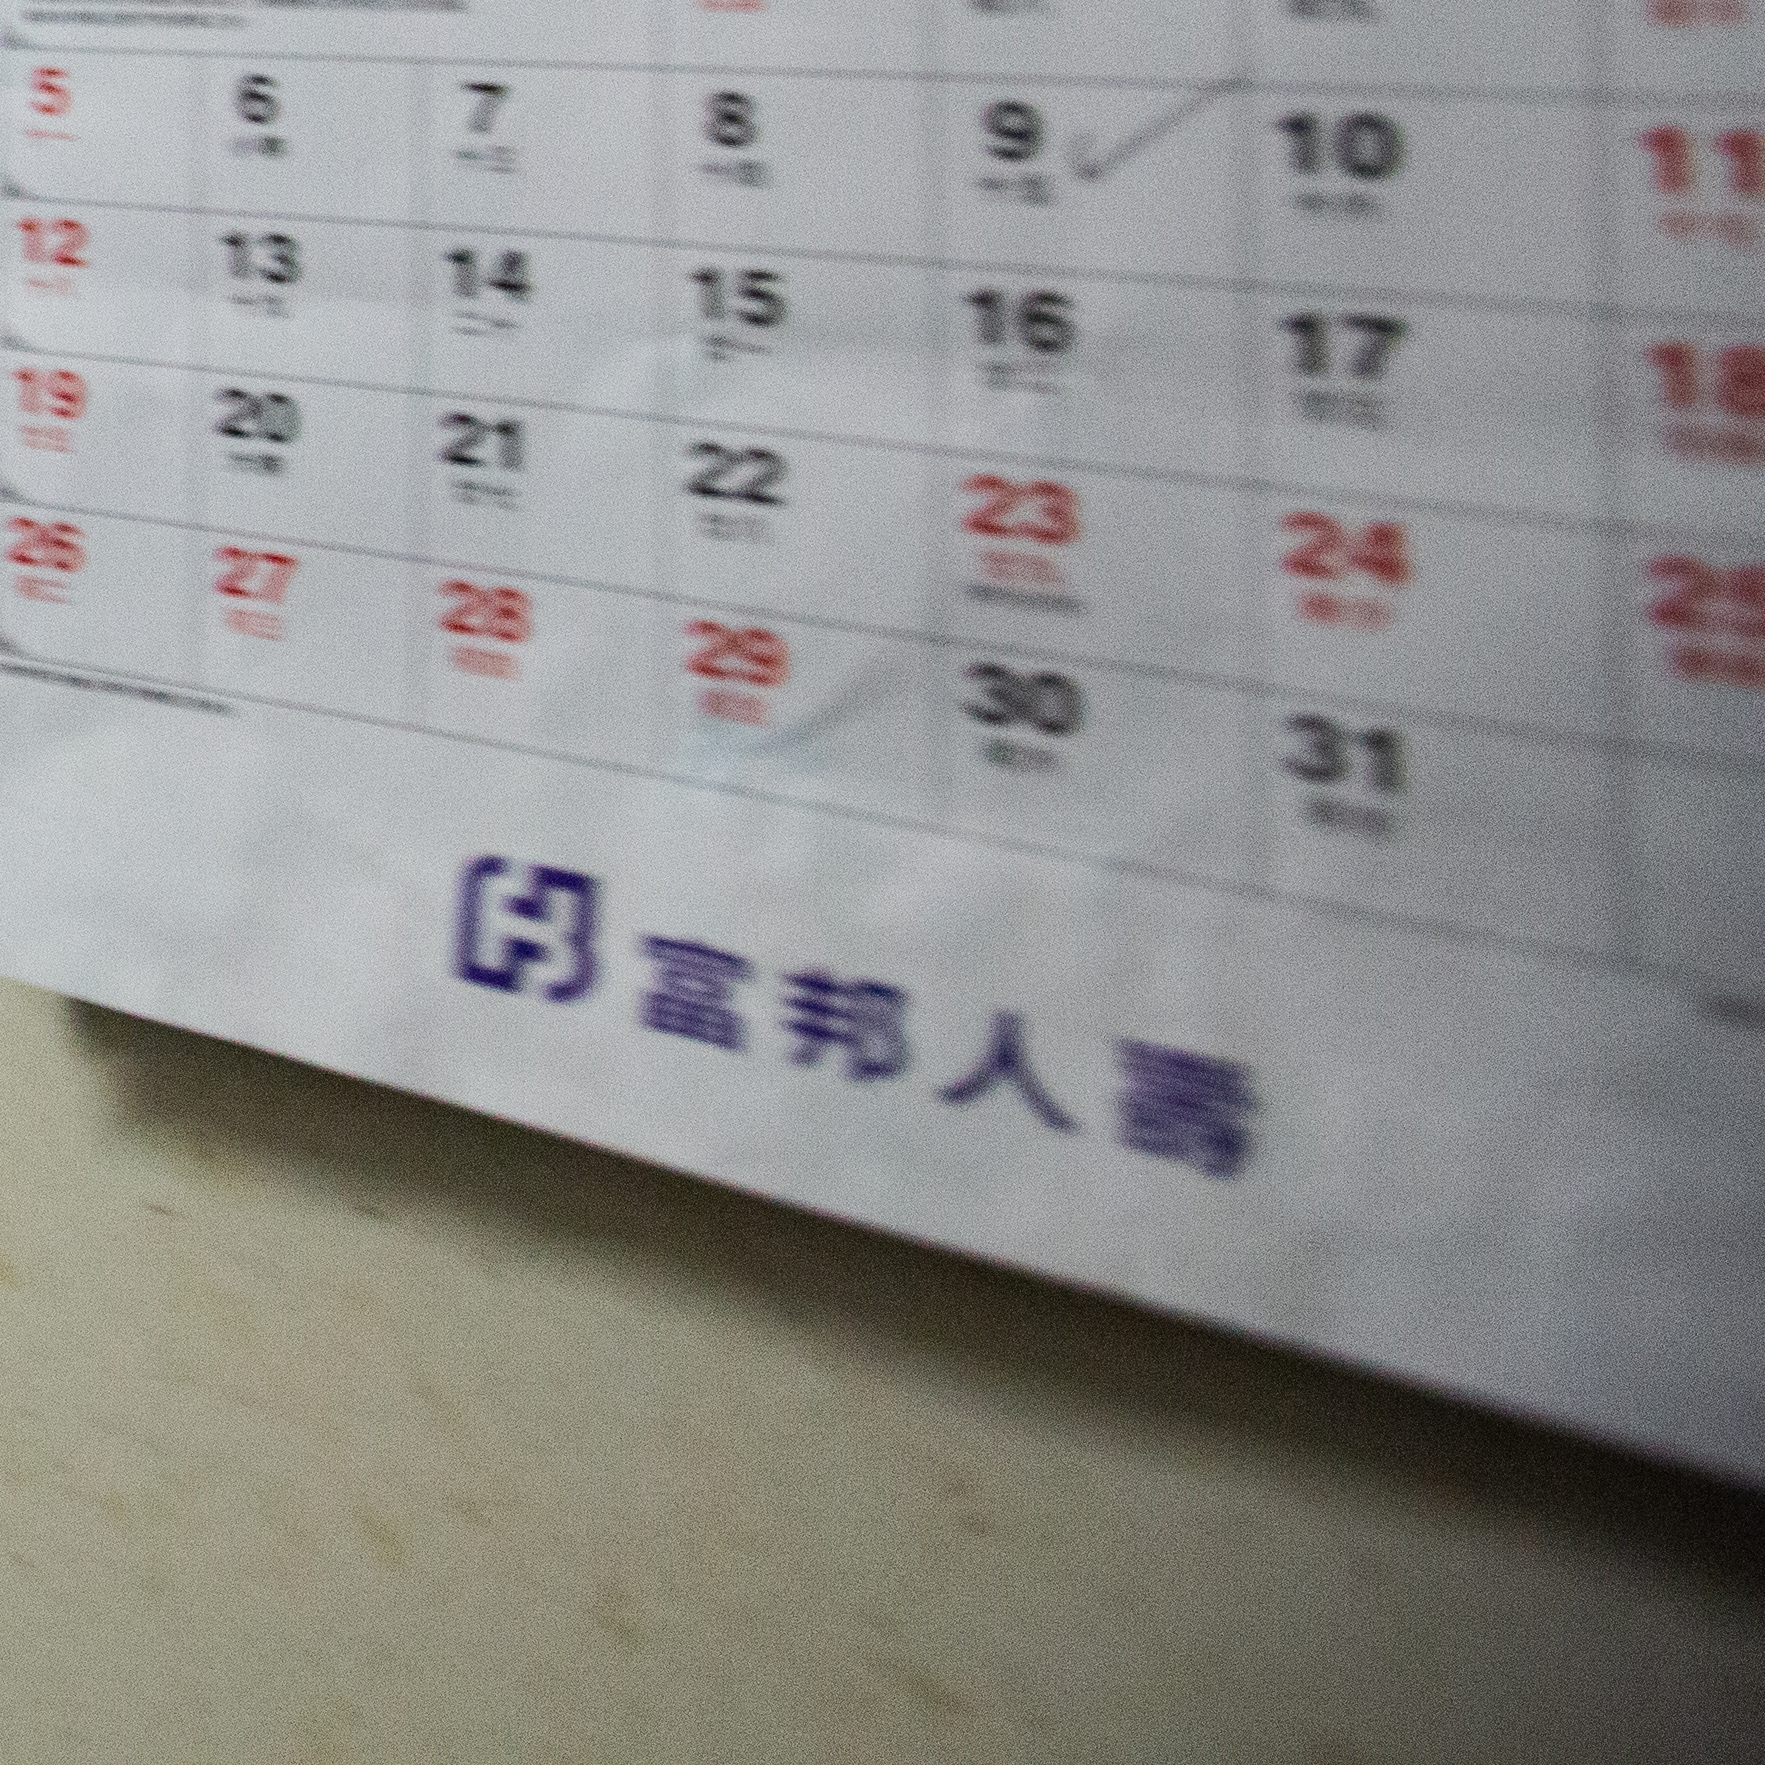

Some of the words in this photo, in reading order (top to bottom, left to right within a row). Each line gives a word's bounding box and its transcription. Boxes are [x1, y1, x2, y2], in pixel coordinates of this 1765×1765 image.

[30, 64, 70, 117] 5
[235, 72, 280, 129] 6
[462, 79, 511, 132] 7
[705, 89, 759, 152] 8
[982, 99, 1045, 166] 9
[1276, 111, 1406, 183] 10
[1640, 125, 1765, 197] 11
[16, 217, 88, 270] 12
[220, 231, 303, 290] 13
[445, 248, 532, 303] 14
[691, 268, 789, 333] 15
[966, 289, 1076, 358] 16
[1281, 311, 1409, 380] 17
[13, 368, 88, 423] 19
[214, 386, 301, 447] 20
[439, 411, 524, 469] 21
[685, 440, 786, 509] 22
[962, 474, 1082, 549] 23
[1282, 512, 1412, 586] 24
[214, 545, 299, 600] 27
[438, 578, 529, 644] 28
[686, 619, 789, 688] 29
[965, 661, 1085, 738] 30
[1285, 713, 1408, 799] 31
